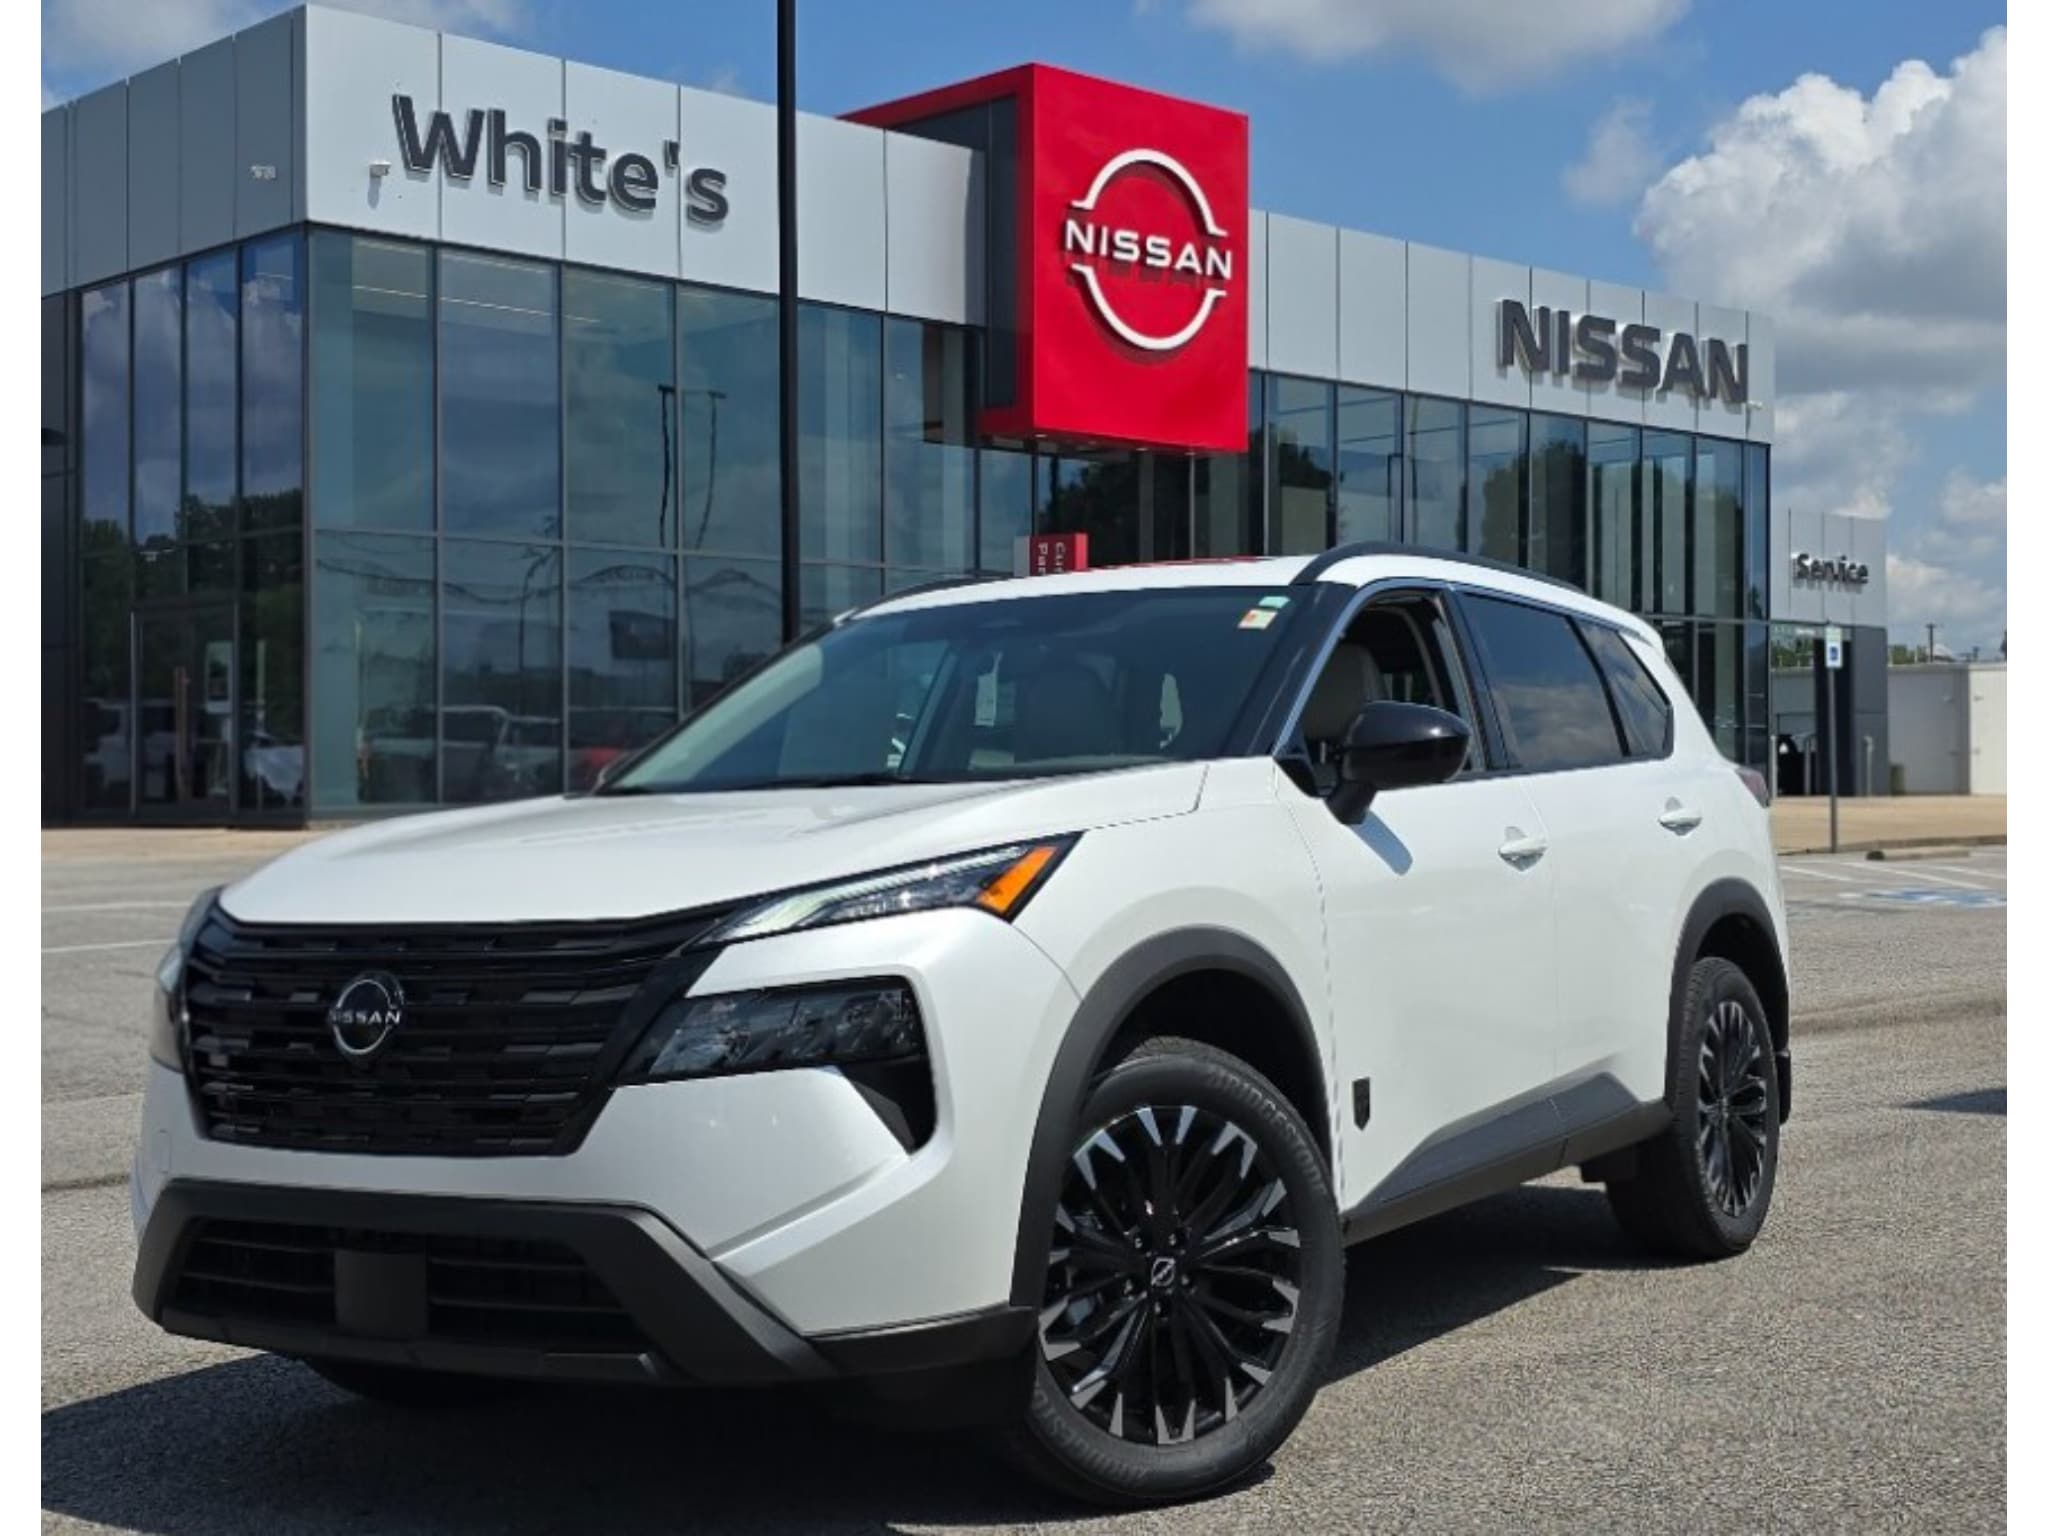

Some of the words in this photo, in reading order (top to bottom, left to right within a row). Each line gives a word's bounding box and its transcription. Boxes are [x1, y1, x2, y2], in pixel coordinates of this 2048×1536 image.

[392, 93, 729, 223] White's
[1066, 219, 1232, 280] NISSAN
[1499, 299, 1749, 404] NISSAN
[1795, 552, 1869, 585] Service
[328, 1010, 400, 1025] NISSAN
